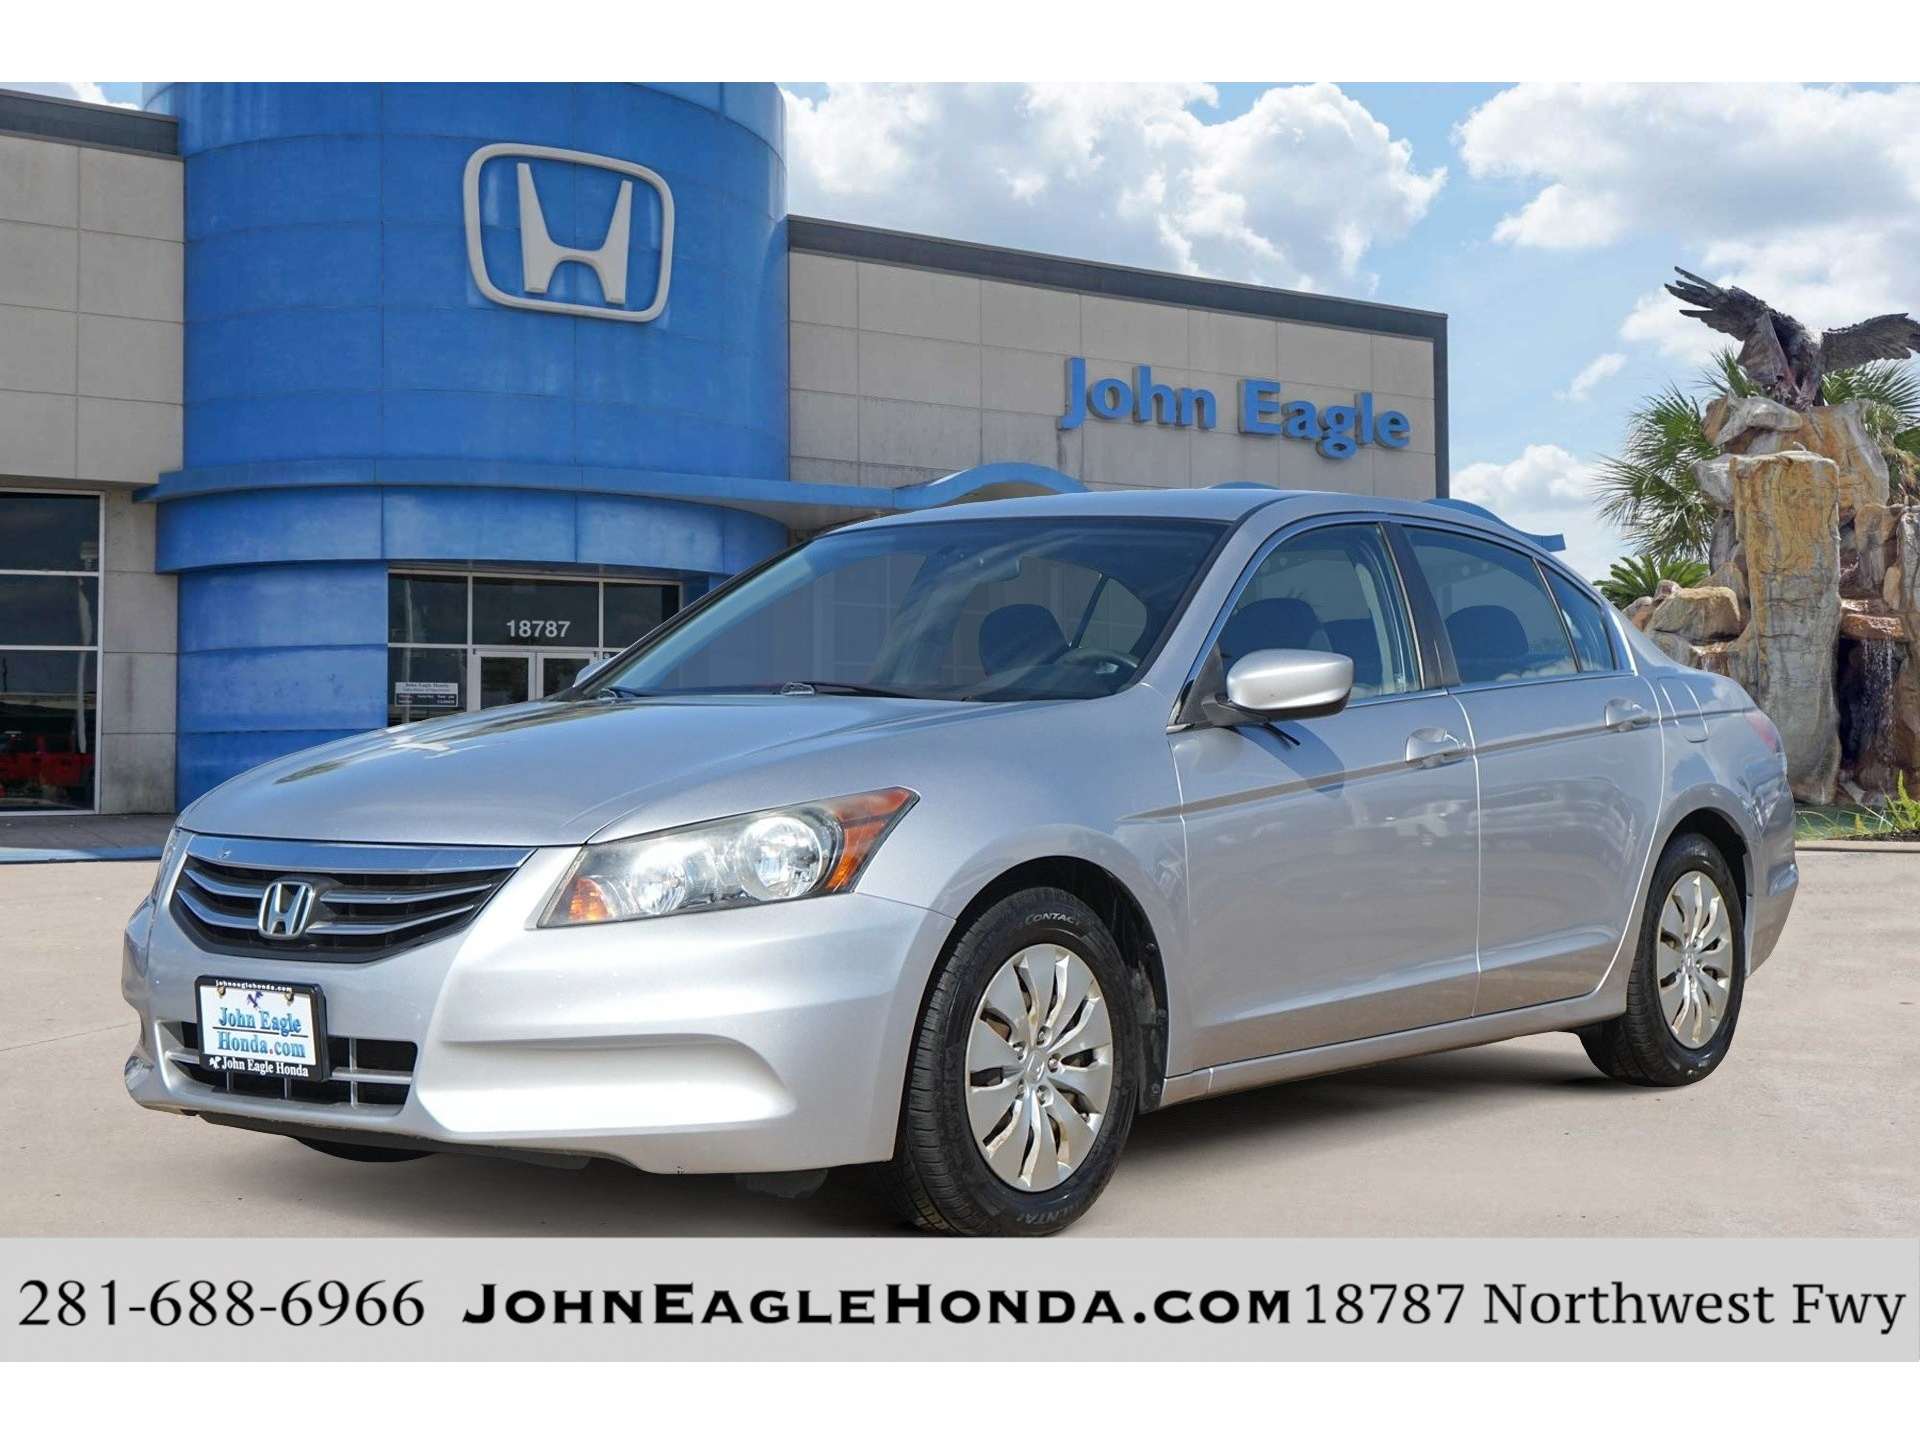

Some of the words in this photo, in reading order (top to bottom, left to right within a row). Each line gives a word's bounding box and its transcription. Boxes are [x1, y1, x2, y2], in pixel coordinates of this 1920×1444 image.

[1056, 357, 1217, 431] John
[1236, 377, 1412, 460] Eagle
[506, 619, 571, 638] 18787
[218, 1006, 256, 1028] John
[259, 1010, 302, 1037] Eagle
[217, 1030, 306, 1058] Honda.com
[221, 1057, 246, 1071] John
[247, 1058, 274, 1076] Eagle
[276, 1061, 309, 1077] Honda
